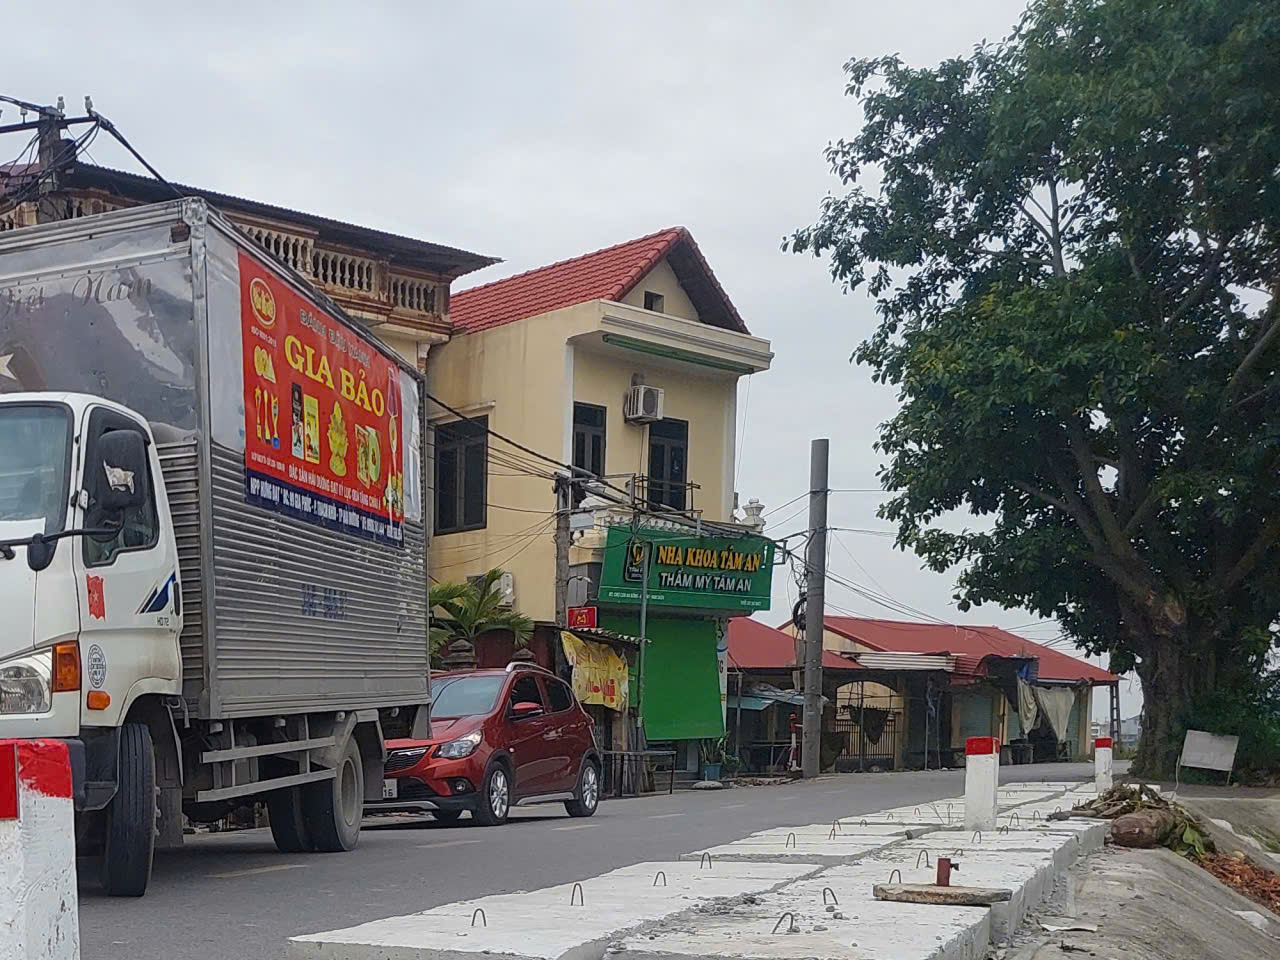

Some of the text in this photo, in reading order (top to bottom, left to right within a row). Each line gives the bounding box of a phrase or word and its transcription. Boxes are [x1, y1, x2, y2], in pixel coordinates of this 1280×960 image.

[284, 334, 386, 418] GIA BẢO
[657, 545, 762, 573] NHA KHOA TÂM AN
[660, 569, 693, 588] THẨM
[713, 573, 737, 592] TÂM
[735, 578, 753, 592] AN
